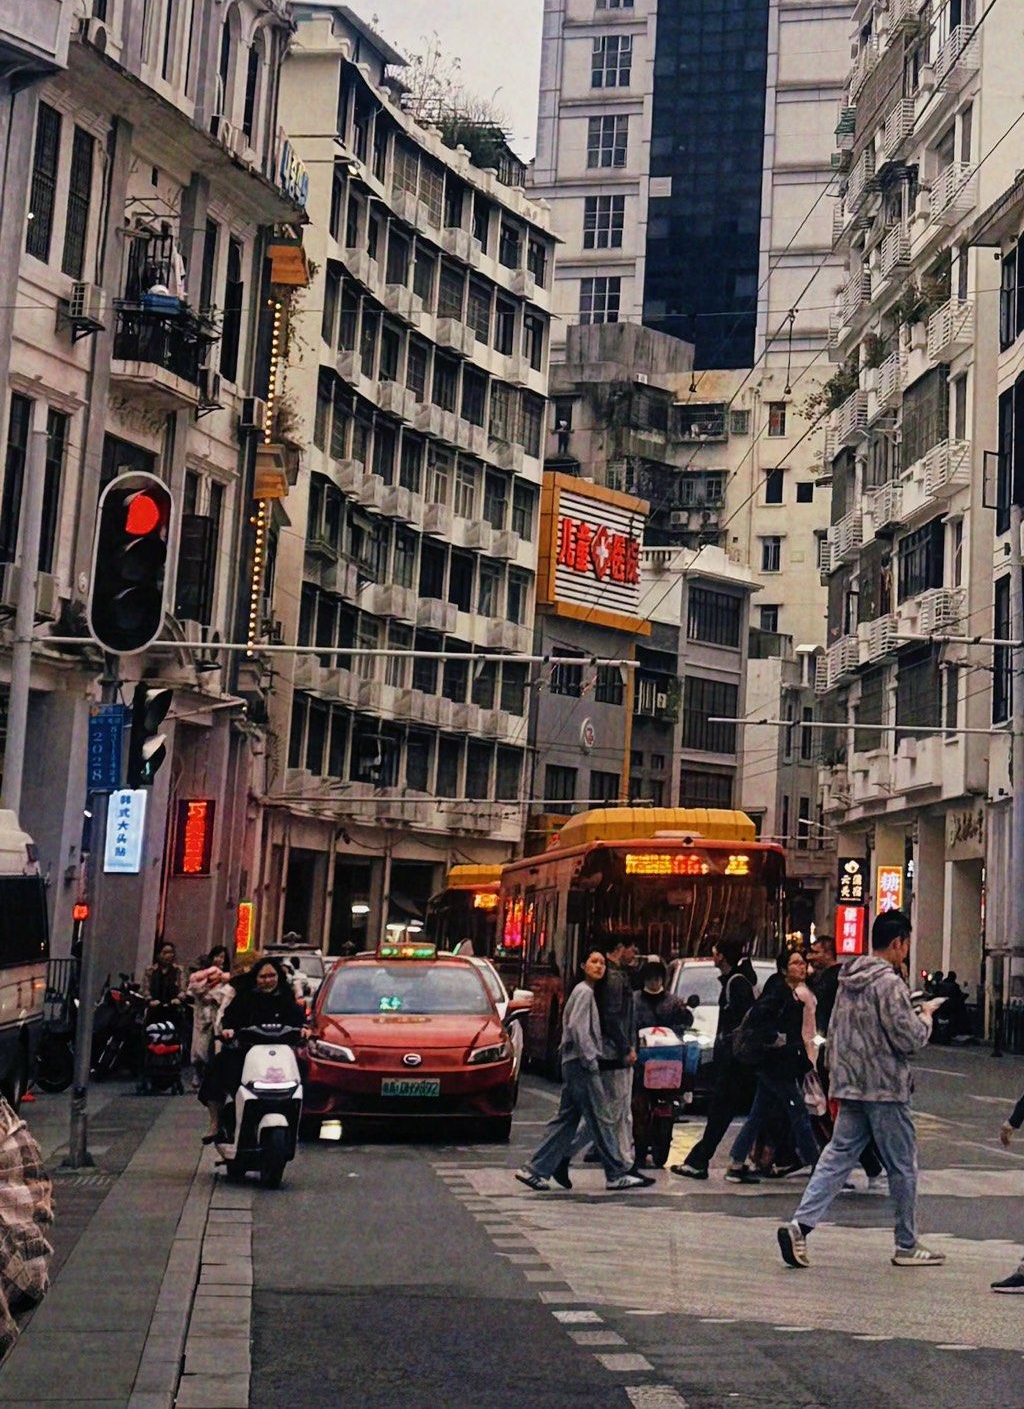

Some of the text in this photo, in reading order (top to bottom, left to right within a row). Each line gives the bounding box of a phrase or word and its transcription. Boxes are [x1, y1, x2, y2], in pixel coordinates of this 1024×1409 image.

[879, 872, 901, 912] 糖水
[842, 907, 858, 953] 便利店
